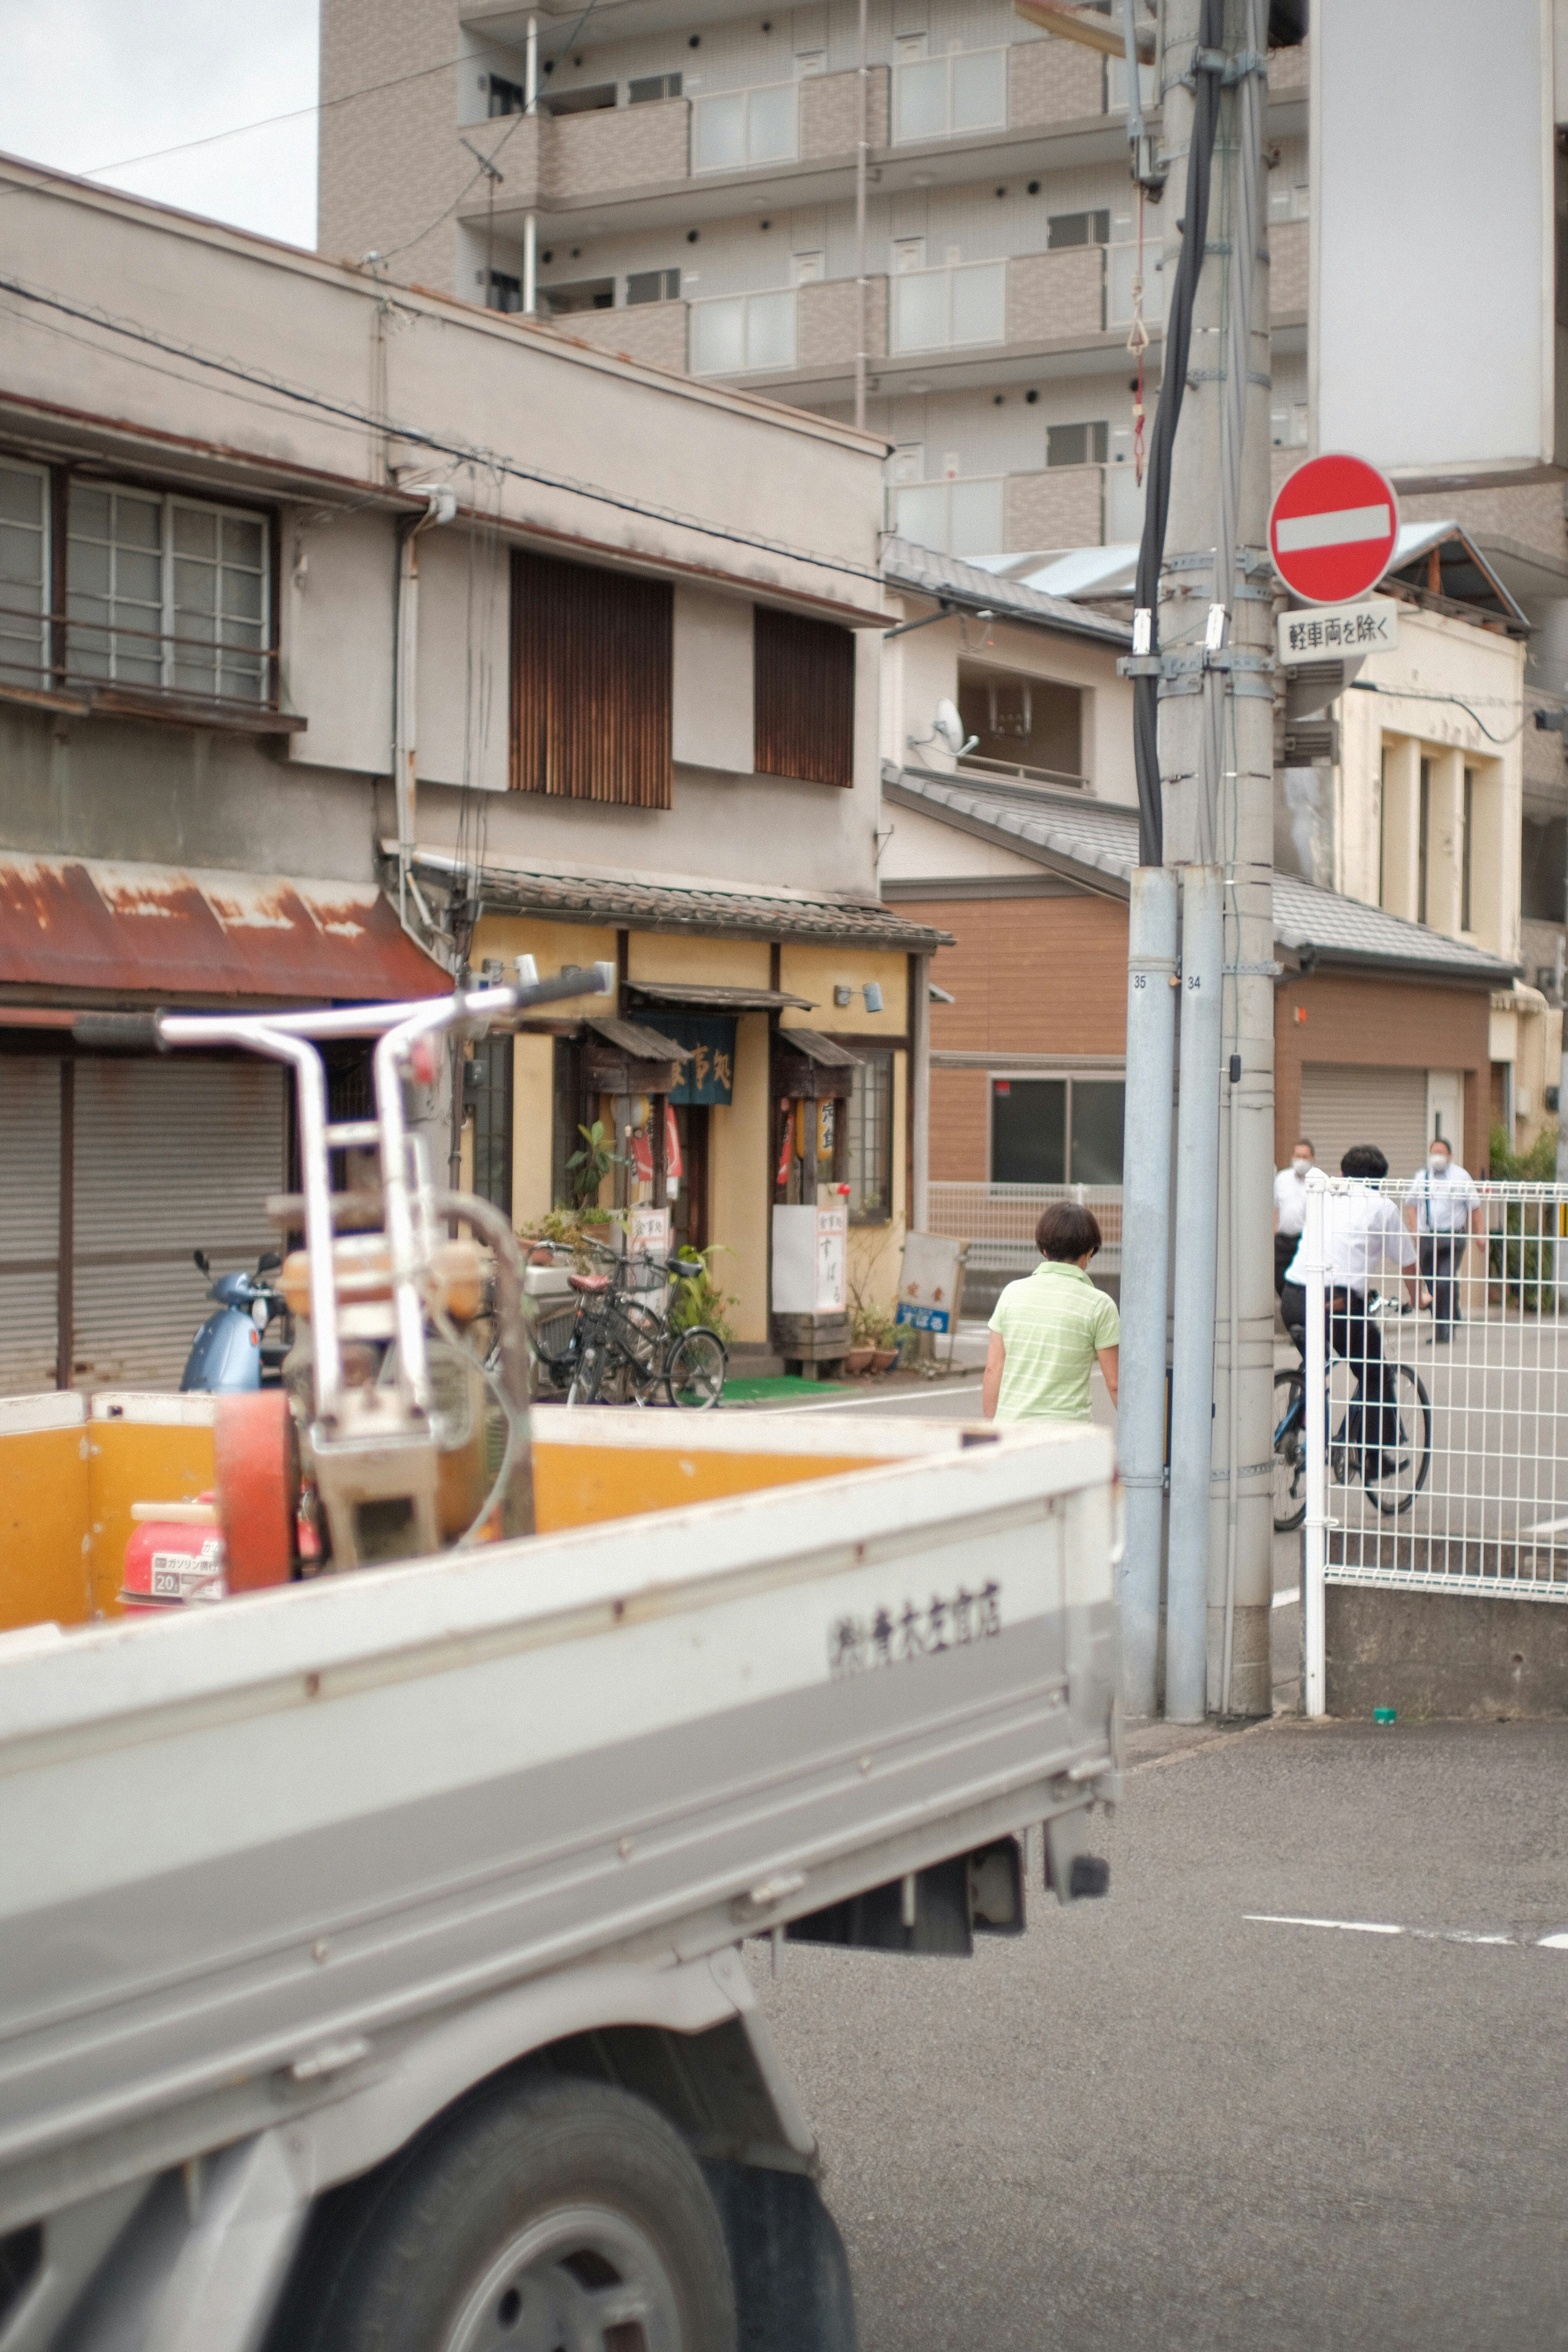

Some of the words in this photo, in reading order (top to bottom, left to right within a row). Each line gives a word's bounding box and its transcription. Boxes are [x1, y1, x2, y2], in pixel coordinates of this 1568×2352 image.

[1289, 615, 1388, 650] 軽車両を除く
[1134, 975, 1146, 989] 35
[1188, 975, 1200, 989] 34
